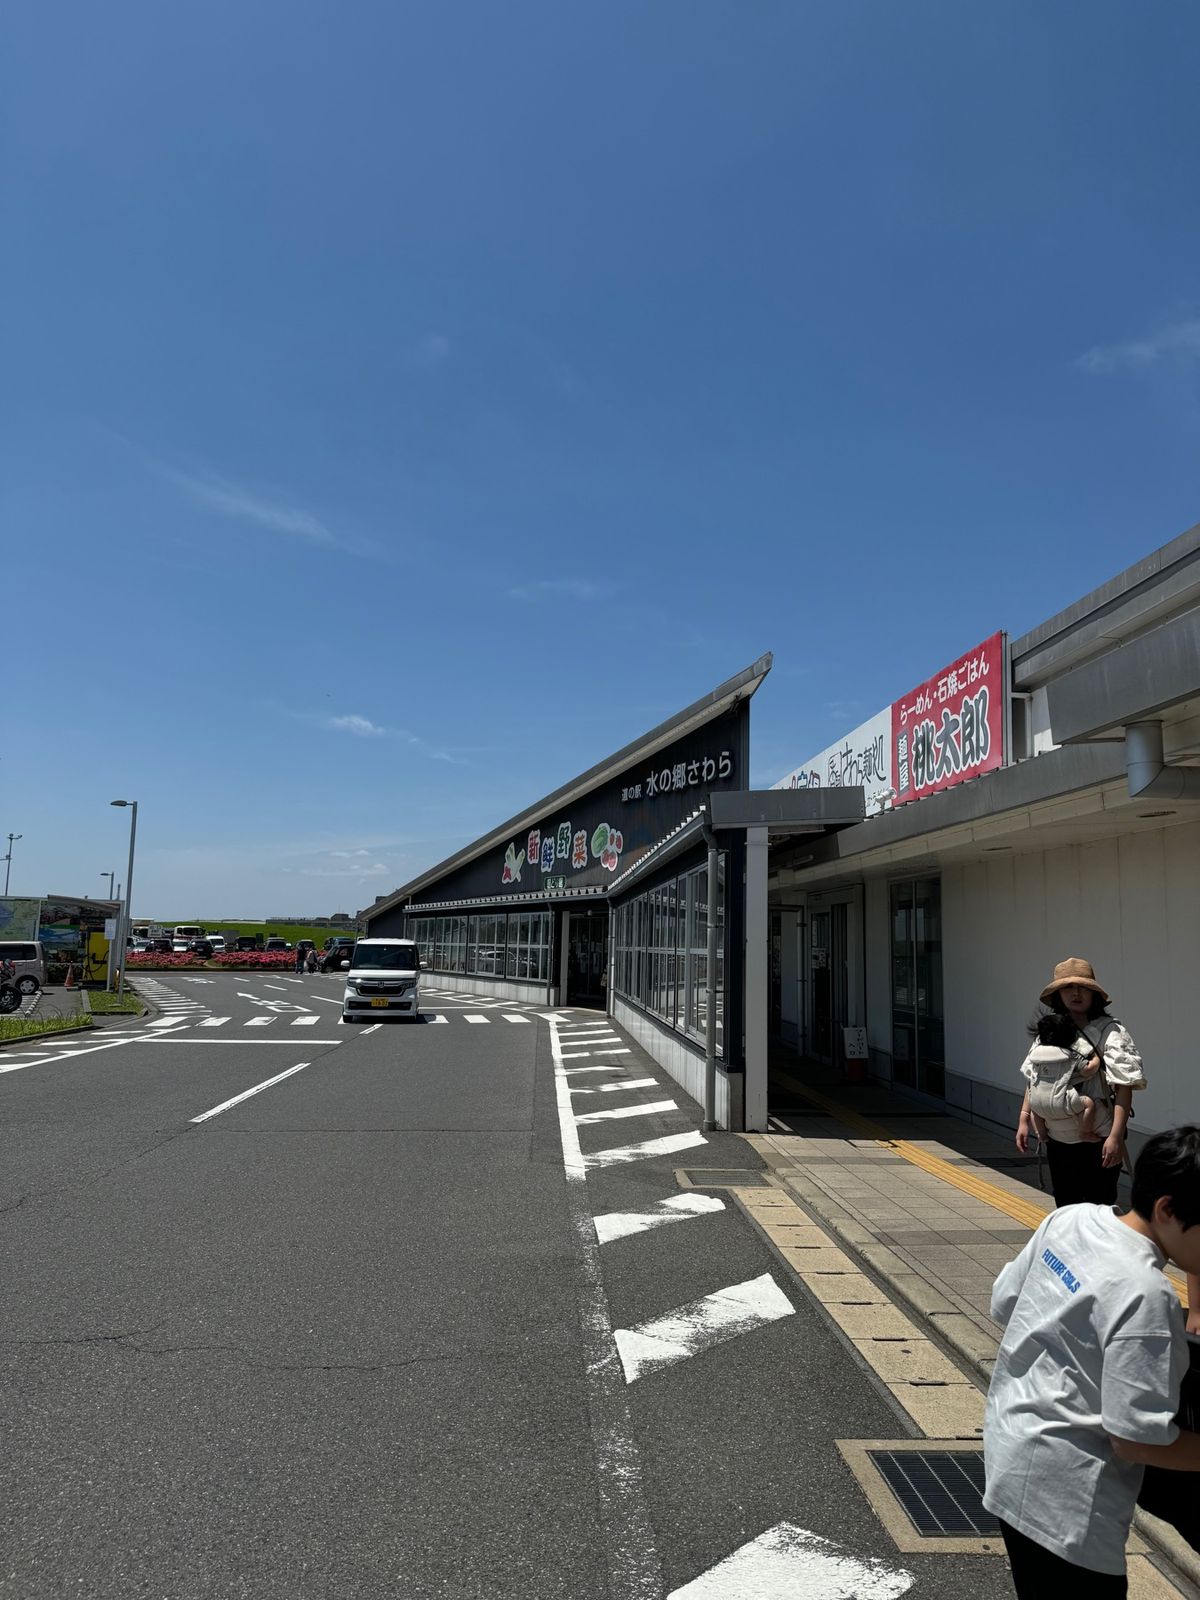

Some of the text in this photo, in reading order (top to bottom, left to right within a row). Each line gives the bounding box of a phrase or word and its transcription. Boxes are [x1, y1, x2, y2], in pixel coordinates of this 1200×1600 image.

[900, 651, 990, 725] らーめん・石焼ごはん
[912, 685, 990, 791] 桃太郎
[621, 751, 732, 802] 道の駅 水の郷さわら
[528, 822, 588, 872] 新鮮野菜
[1041, 1248, 1067, 1277] FUTURE
